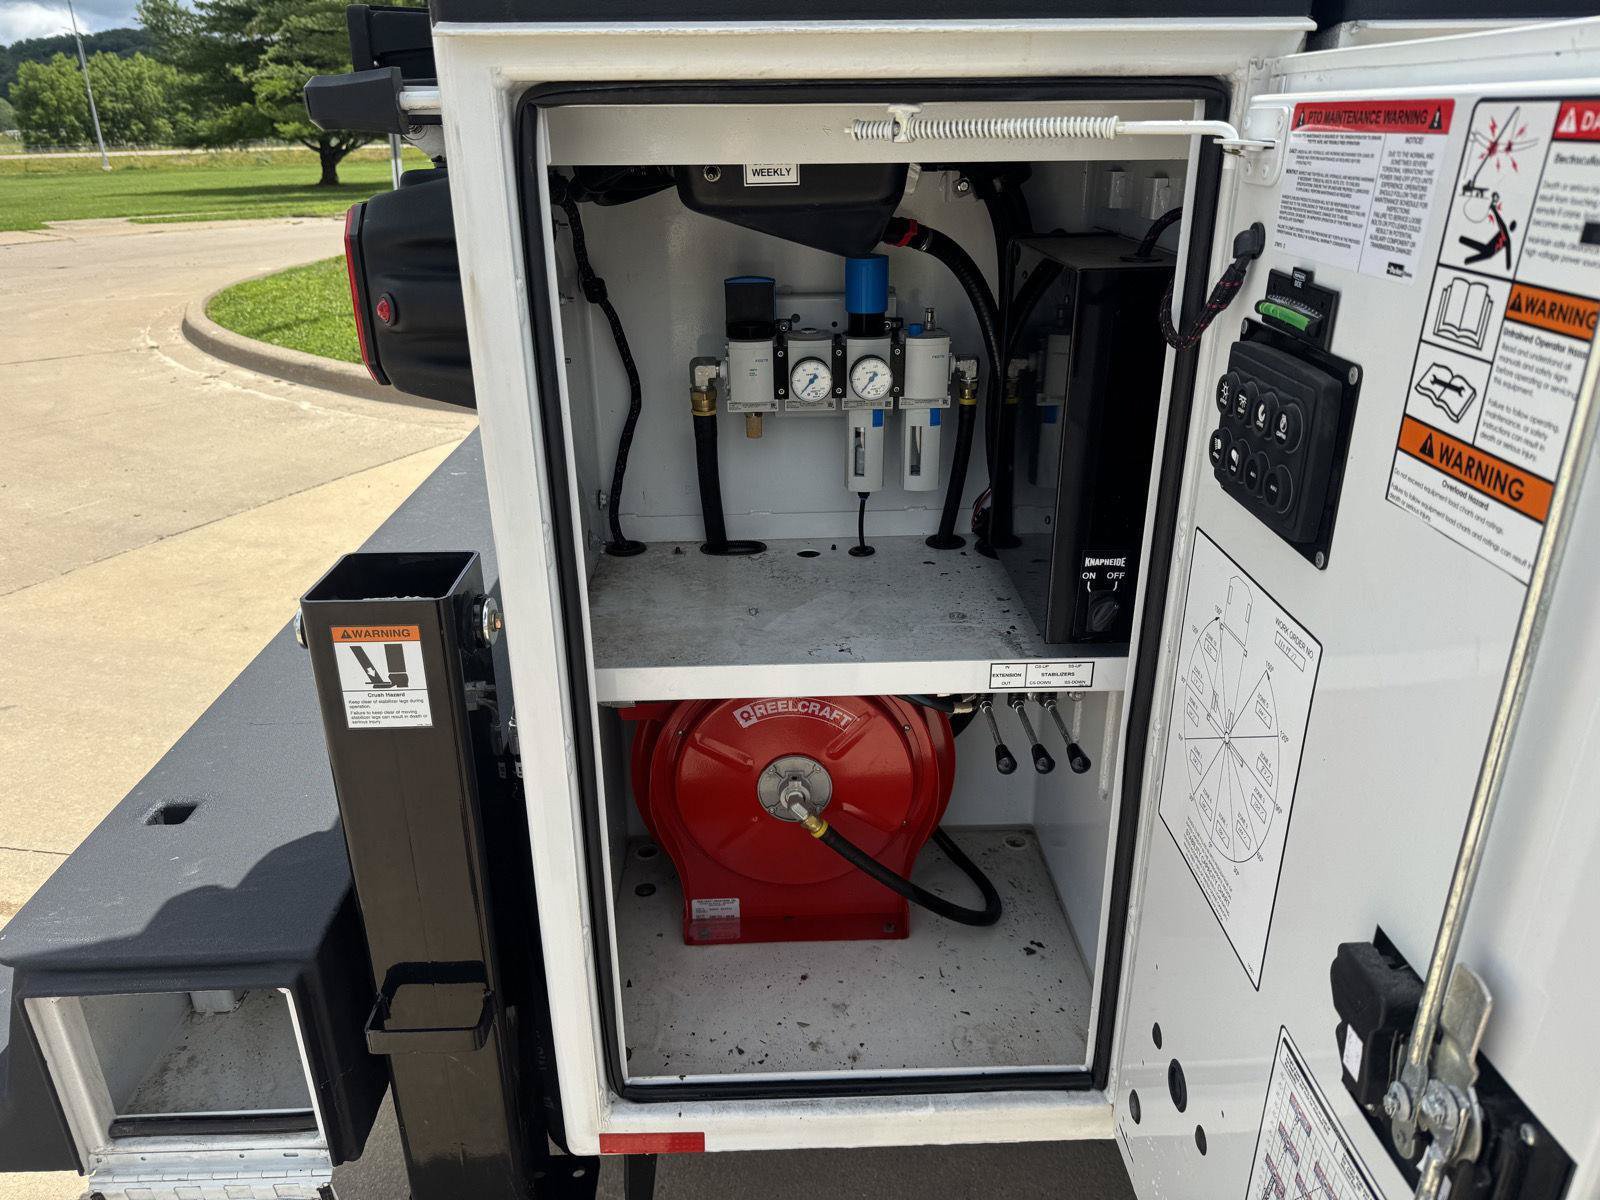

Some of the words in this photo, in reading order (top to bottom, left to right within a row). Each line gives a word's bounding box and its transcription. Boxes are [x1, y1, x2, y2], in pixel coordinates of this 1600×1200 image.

[1307, 110, 1323, 124] PTO
[1323, 110, 1380, 124] MAINTENANCE
[1382, 110, 1428, 125] WARNING
[752, 168, 792, 176] WEEKLY
[1524, 293, 1597, 330] WARNING
[1501, 343, 1516, 353] Read
[1517, 348, 1528, 357] and
[1529, 351, 1563, 367] understand
[1534, 336, 1566, 353] Operator
[1495, 366, 1513, 379] before
[1514, 372, 1542, 388] operating
[1543, 381, 1549, 390] or
[1522, 362, 1534, 372] and
[1534, 366, 1552, 378] safety
[1487, 398, 1504, 412] Failure
[1505, 404, 1512, 415] to
[1511, 407, 1528, 421] follow
[1479, 431, 1495, 444] death
[1496, 438, 1502, 447] or
[1502, 440, 1521, 455] serious
[1511, 432, 1522, 443] can
[1523, 437, 1538, 449] result
[1539, 443, 1545, 452] in
[1522, 424, 1528, 434] or
[1529, 427, 1548, 441] safety
[1438, 442, 1525, 502] WARNING
[1407, 474, 1423, 490] exceed
[1424, 483, 1447, 503] equipment
[1448, 497, 1459, 510] load
[1459, 503, 1474, 518] charts
[1474, 511, 1485, 524] and
[1441, 480, 1467, 499] Overload
[1467, 493, 1489, 511] Hazard
[1408, 493, 1420, 505] follow
[1421, 500, 1444, 520] equipment
[1445, 514, 1455, 526] load
[1456, 521, 1471, 535] charts
[1471, 529, 1482, 542] and
[1482, 536, 1500, 552] ratings
[1500, 546, 1511, 559] can
[1084, 557, 1126, 567] KNAPHEIDE
[1082, 572, 1096, 580] ON
[1107, 572, 1125, 580] OFF
[351, 629, 410, 637] WARNING
[1275, 616, 1288, 636] WORK
[1289, 630, 1305, 652] ORDER
[754, 700, 852, 727] REELCRAFT
